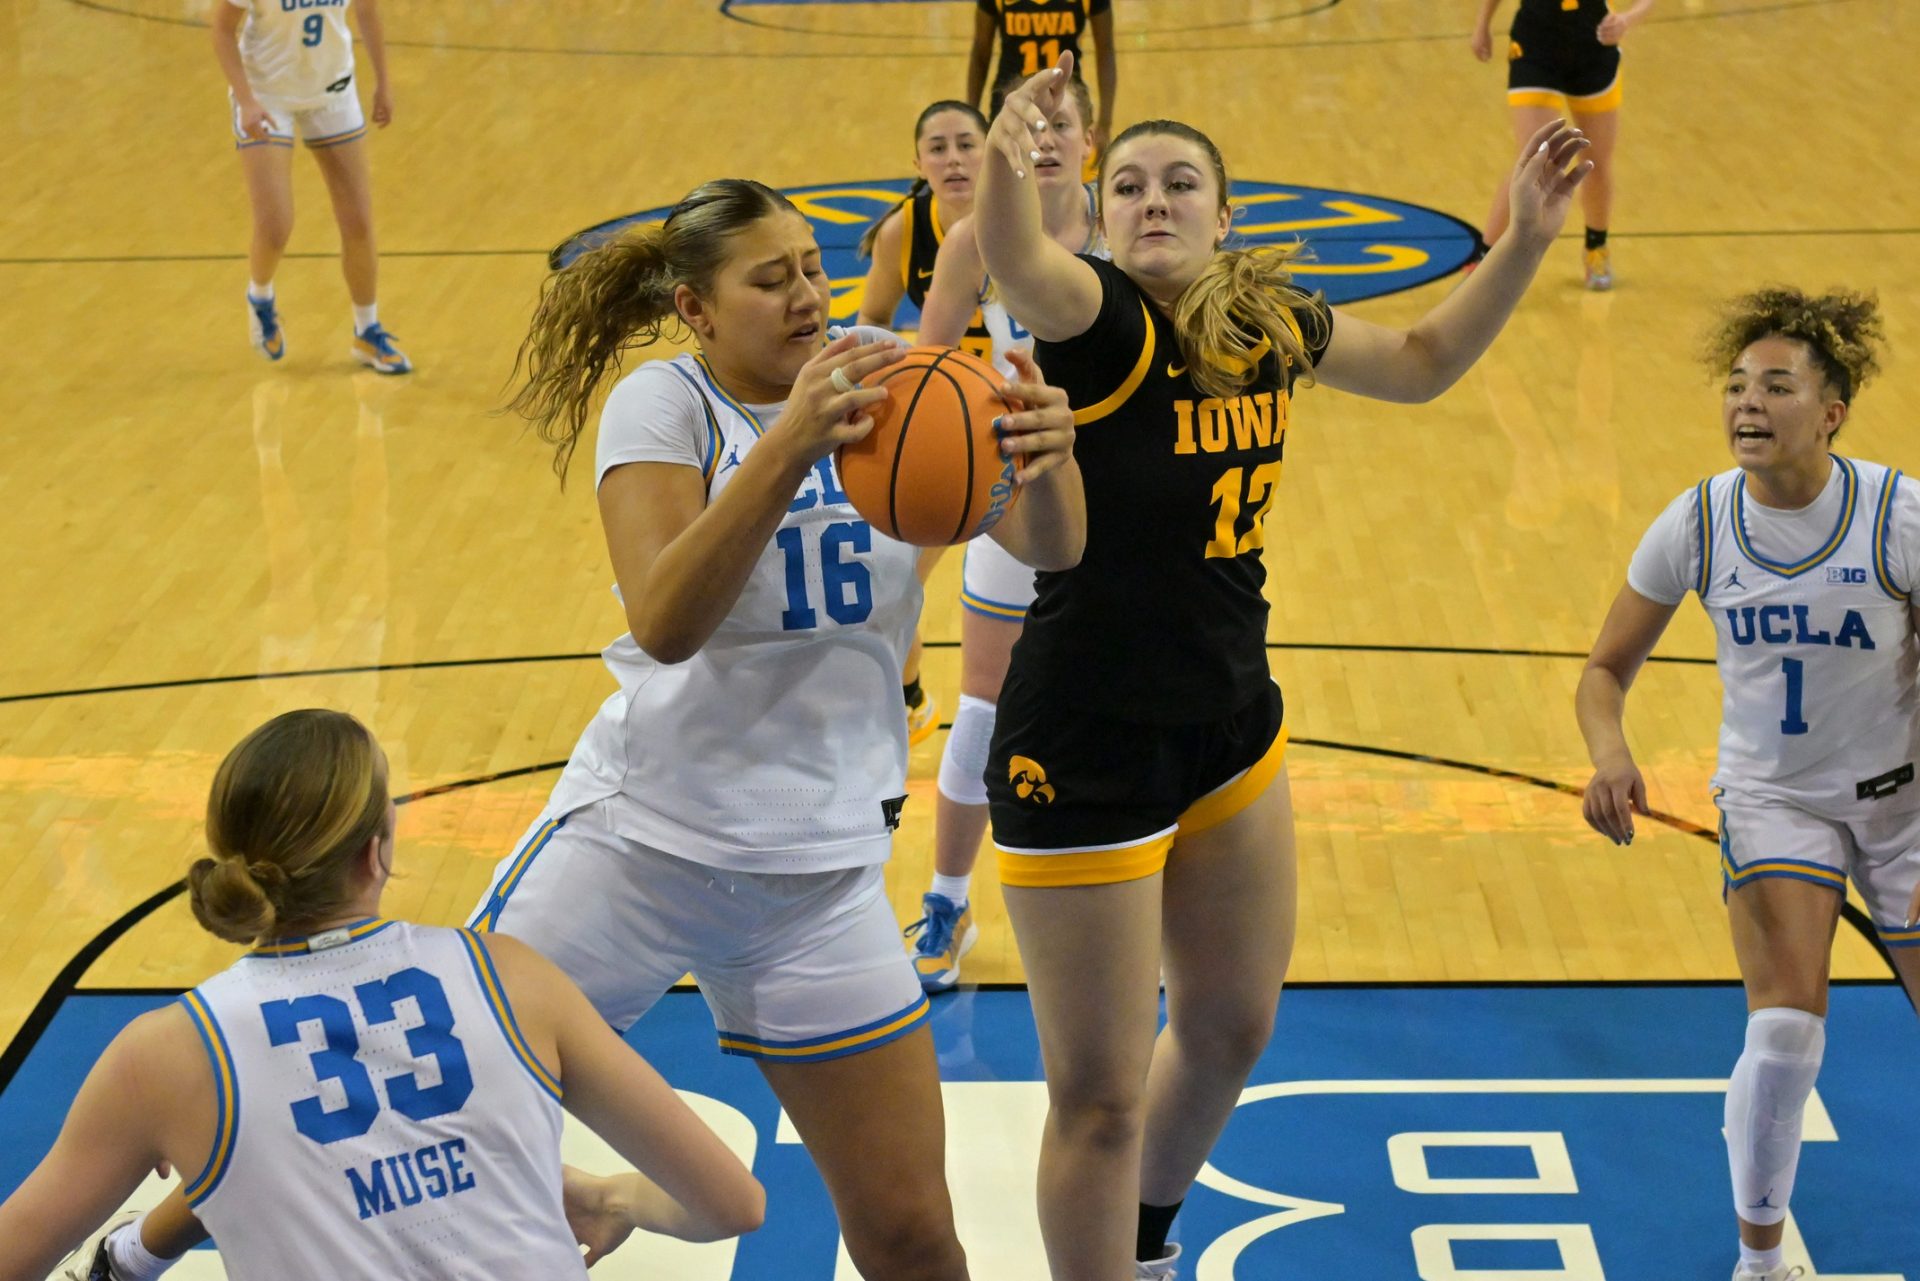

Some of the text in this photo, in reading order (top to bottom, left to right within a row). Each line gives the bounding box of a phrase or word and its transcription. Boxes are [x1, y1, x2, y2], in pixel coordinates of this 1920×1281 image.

[302, 13, 323, 48] 9
[1005, 11, 1076, 36] IOWA
[1020, 38, 1060, 77] 11
[1174, 388, 1292, 454] IOWA
[1204, 460, 1282, 559] 12
[775, 520, 873, 631] 16
[1726, 604, 1876, 650] UCLA
[1780, 656, 1809, 735] 1
[260, 967, 474, 1145] 33
[344, 1137, 476, 1220] MUSE
